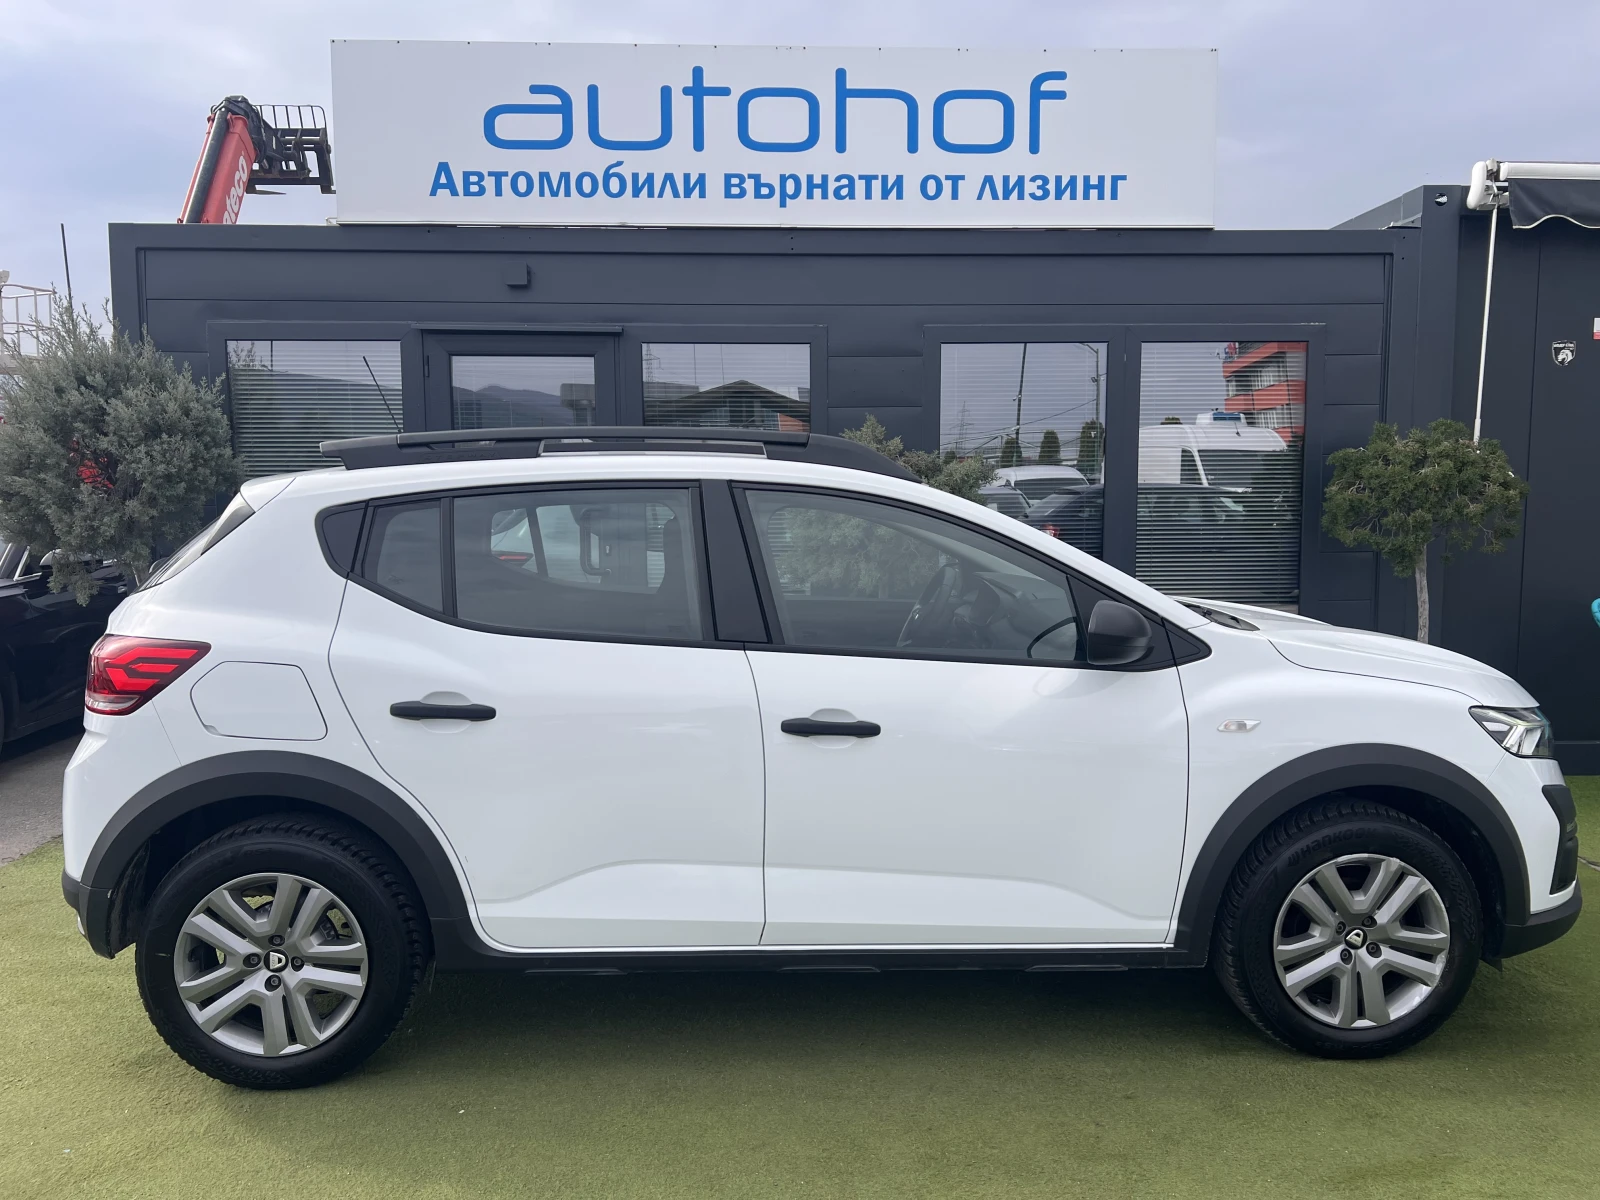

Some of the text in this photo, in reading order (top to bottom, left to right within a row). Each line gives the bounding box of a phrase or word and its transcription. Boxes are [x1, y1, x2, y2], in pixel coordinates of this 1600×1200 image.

[482, 65, 1068, 156] autohof
[429, 160, 1128, 209] Автомобили върнати от лизинг
